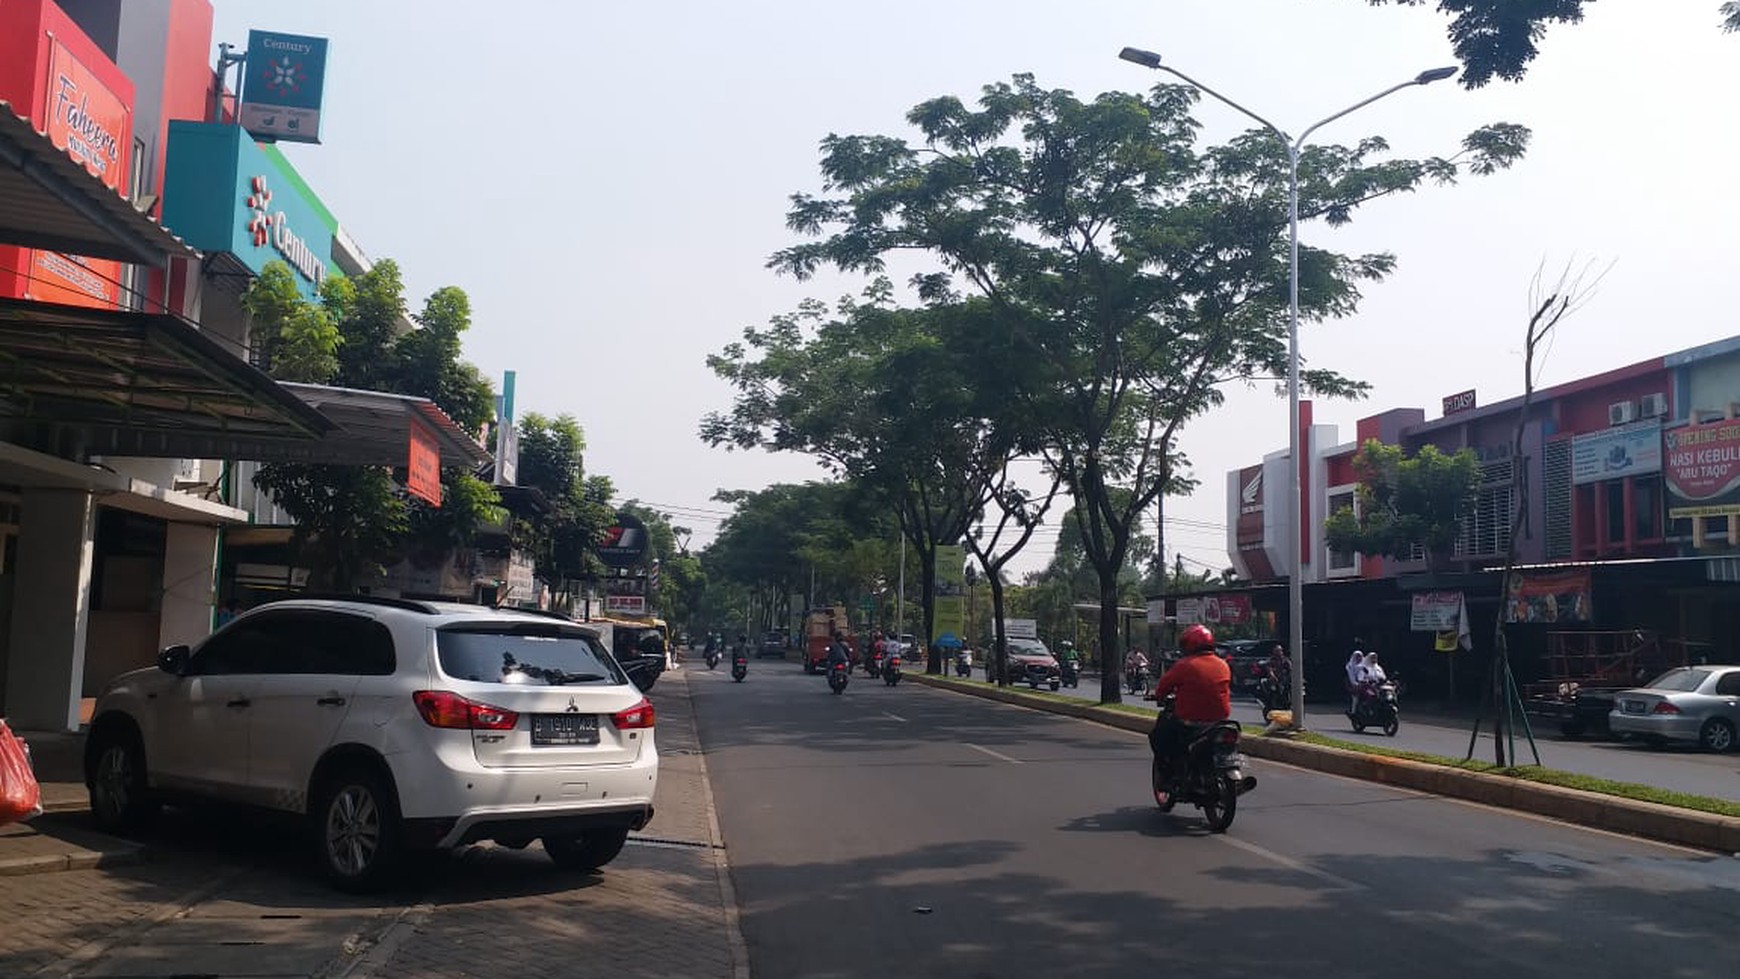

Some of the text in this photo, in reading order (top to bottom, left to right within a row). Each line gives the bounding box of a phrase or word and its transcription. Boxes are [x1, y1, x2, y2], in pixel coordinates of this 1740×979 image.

[262, 38, 312, 55] Century
[272, 210, 327, 298] Century
[1670, 451, 1695, 467] NASI
